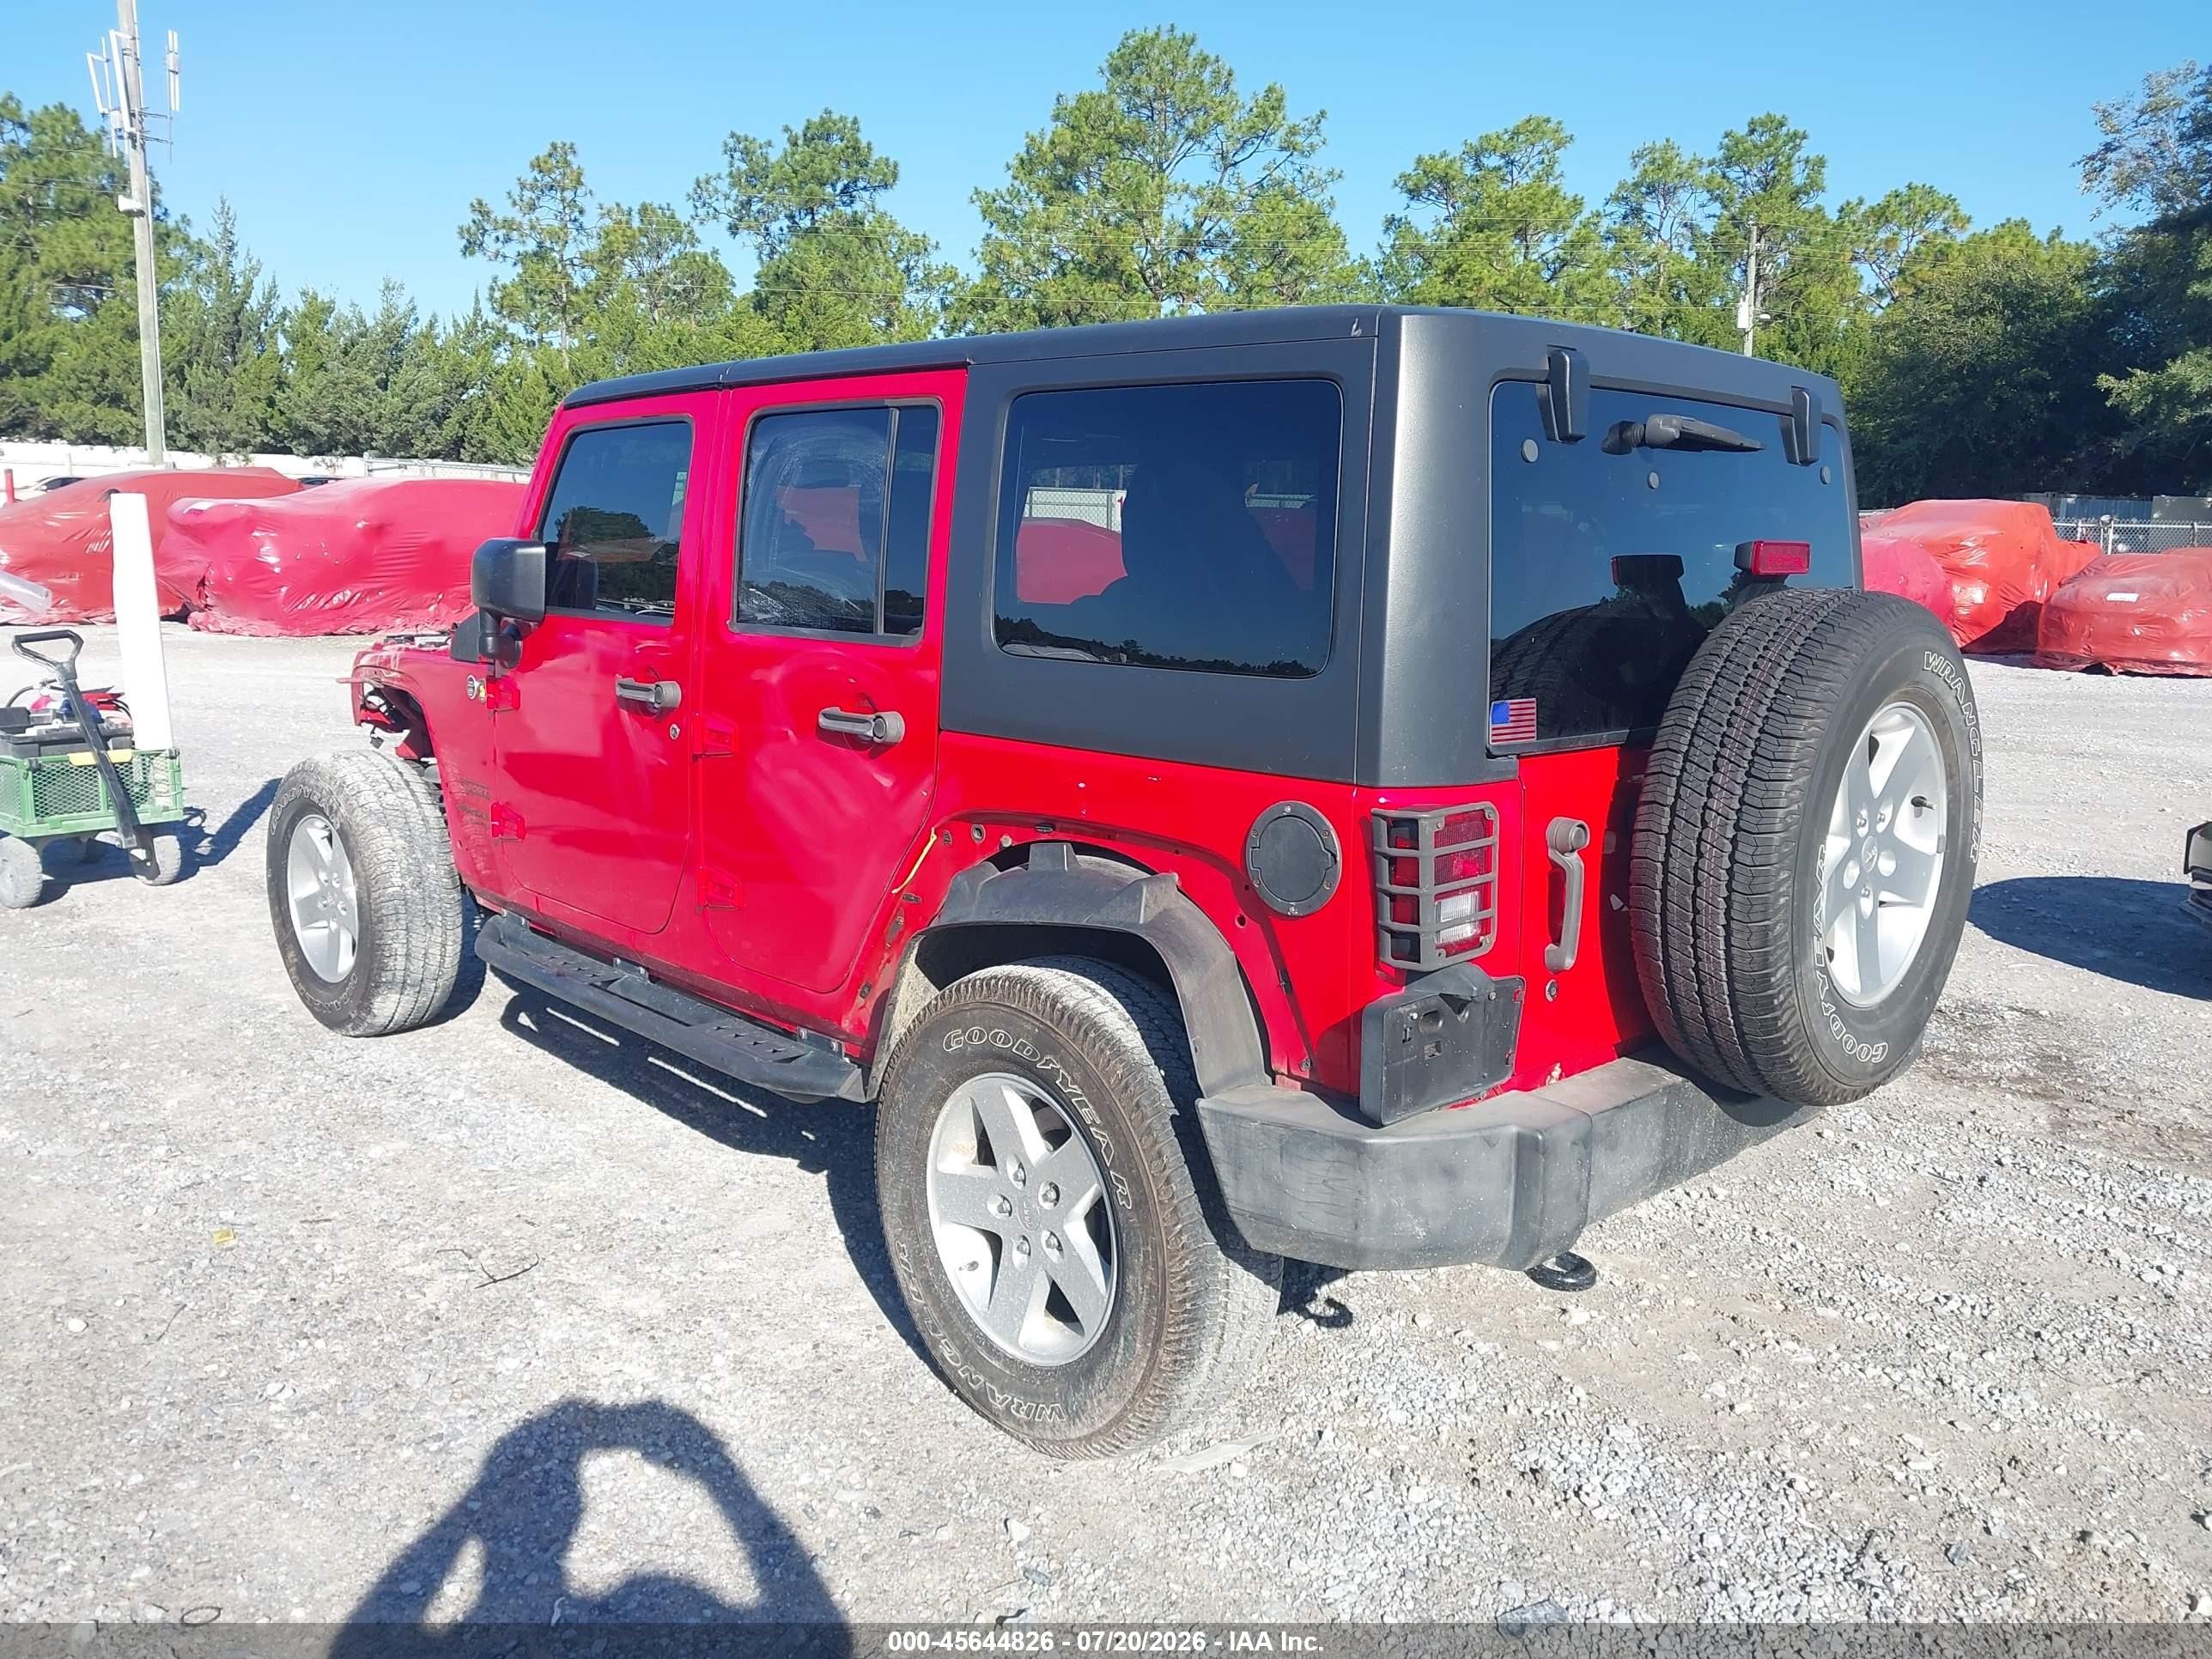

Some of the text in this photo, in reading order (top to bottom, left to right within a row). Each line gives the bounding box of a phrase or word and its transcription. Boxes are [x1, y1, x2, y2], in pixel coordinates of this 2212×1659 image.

[270, 784, 340, 836] GOODYEAR
[1923, 651, 1983, 864] WRANGLER
[1813, 844, 1888, 1063] GOODYEAR
[943, 1026, 1132, 1209] GOODYEAR
[895, 1240, 1066, 1422] WRANGLER
